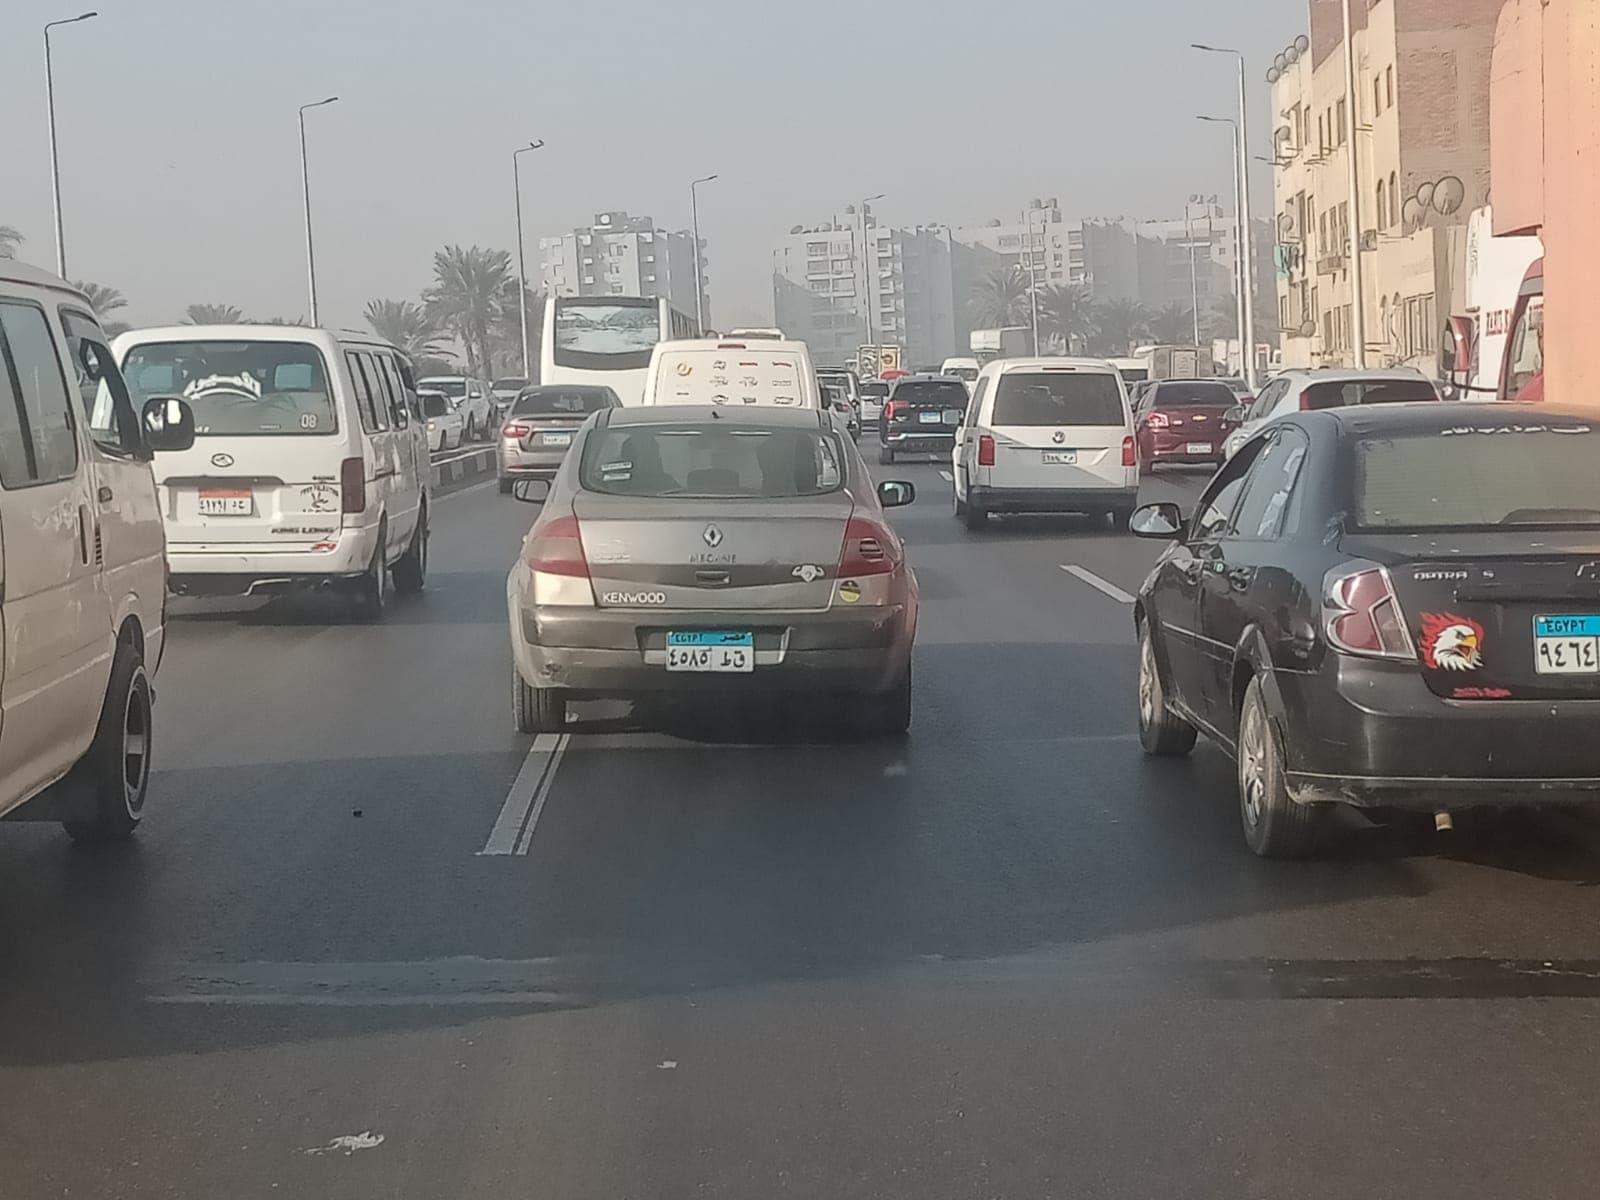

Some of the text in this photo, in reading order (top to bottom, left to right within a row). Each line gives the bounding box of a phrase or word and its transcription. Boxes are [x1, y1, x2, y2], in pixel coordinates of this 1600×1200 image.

[301, 414, 317, 428] 08
[602, 592, 666, 603] KENWOOD
[1547, 620, 1586, 633] EGYPT
[720, 633, 746, 643] مصر
[670, 649, 708, 667] ٤٥٨٥
[1540, 642, 1596, 667] ٩٤٦٤
